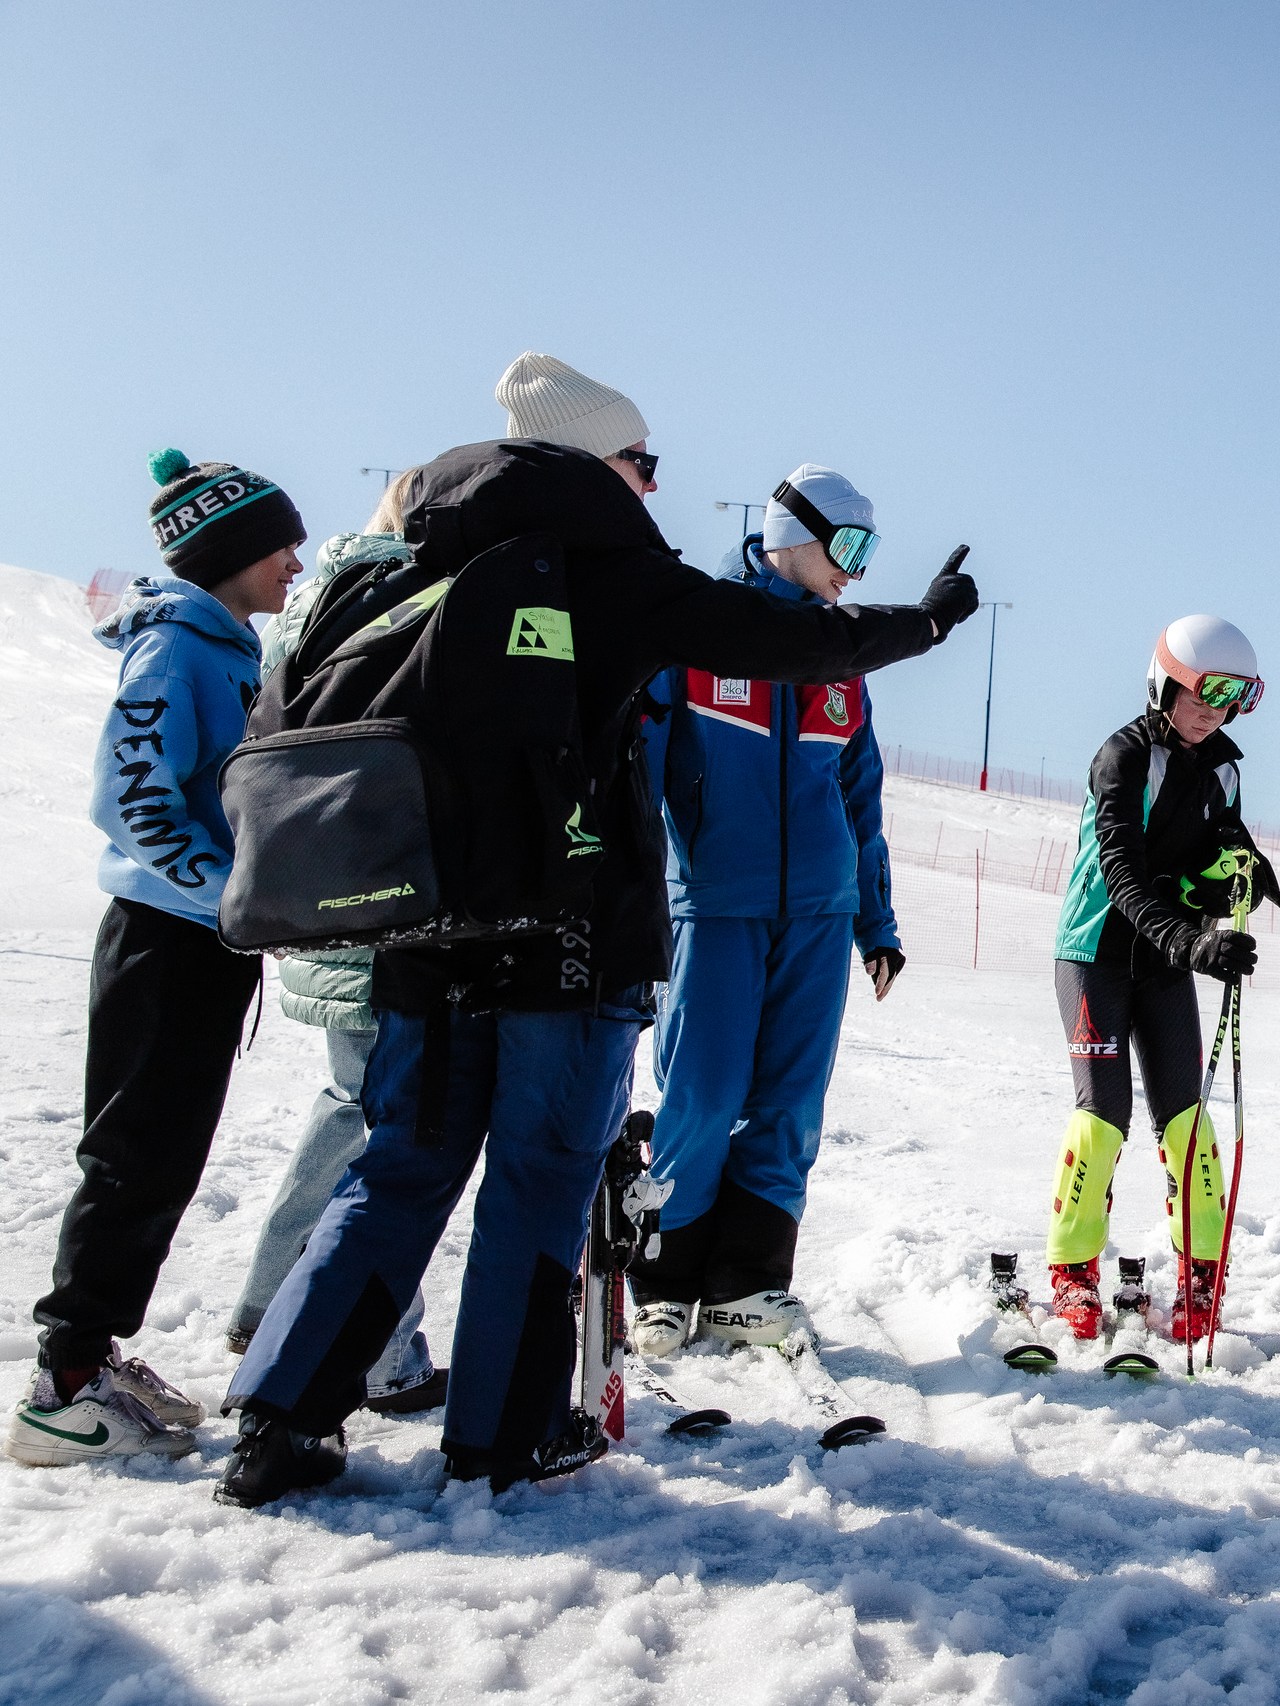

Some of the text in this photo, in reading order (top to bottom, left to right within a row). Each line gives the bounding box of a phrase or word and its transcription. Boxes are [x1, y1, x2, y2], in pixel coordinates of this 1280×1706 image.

[318, 887, 402, 910] FISCHER
[1068, 1043, 1118, 1055] DEUTZ
[1212, 1015, 1228, 1062] LEKI
[1071, 1160, 1087, 1204] LEKI
[1200, 1153, 1213, 1196] LEKI
[701, 1309, 763, 1328] HEAD
[600, 1370, 622, 1410] 145
